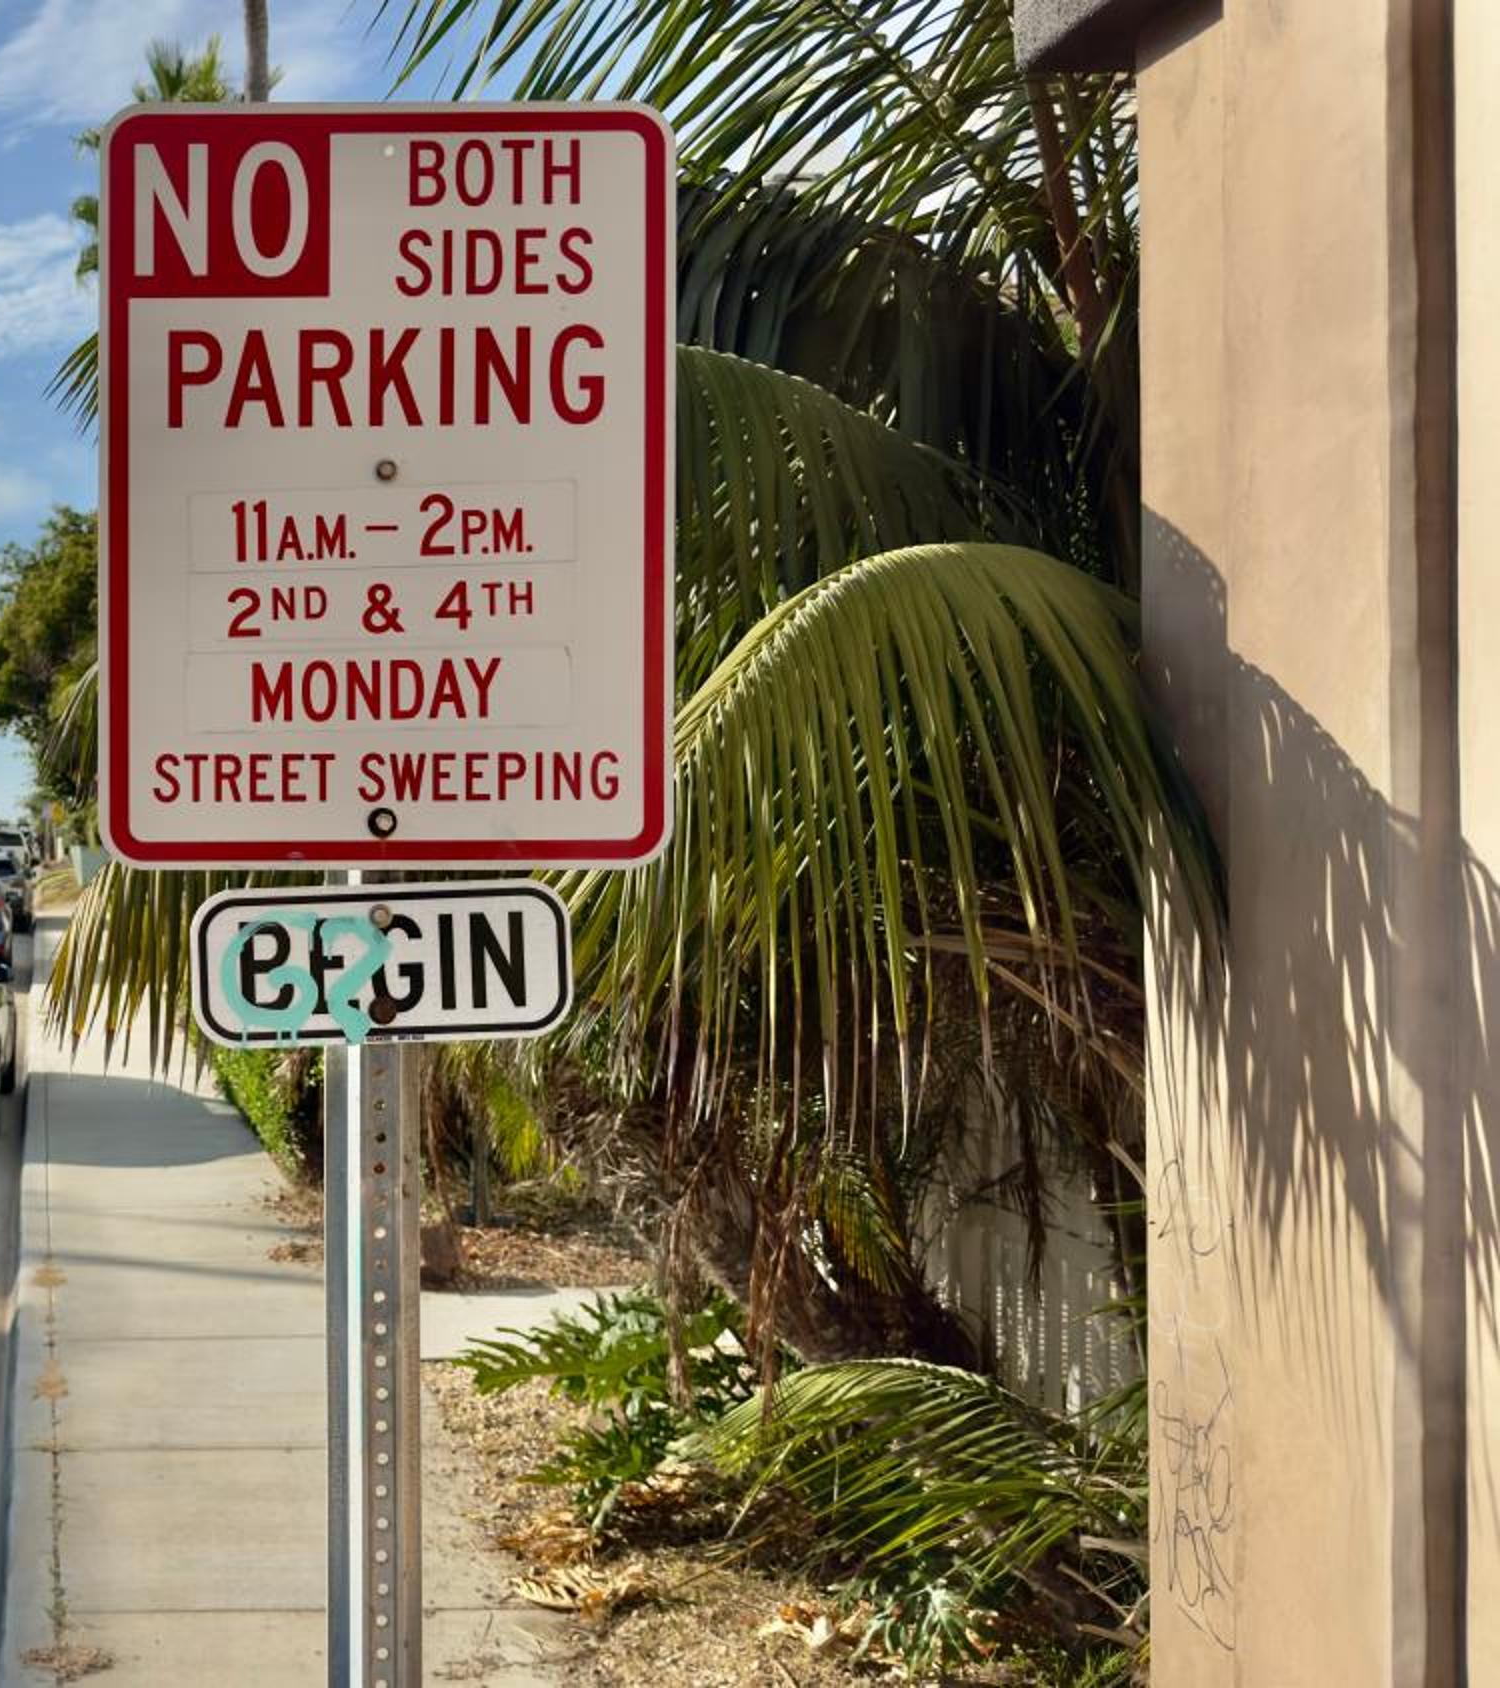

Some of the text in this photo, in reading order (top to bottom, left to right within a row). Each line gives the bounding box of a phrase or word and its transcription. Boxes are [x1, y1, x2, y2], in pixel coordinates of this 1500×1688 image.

[408, 138, 582, 208] BOTH
[133, 142, 309, 278] NO
[394, 227, 594, 297] SIDES
[167, 323, 606, 429] PARKING
[419, 493, 534, 557] 2P.M.
[227, 576, 534, 639] 2ND & 4TH
[250, 656, 502, 724] MONDAY
[152, 749, 621, 804] STREET SWEEPING
